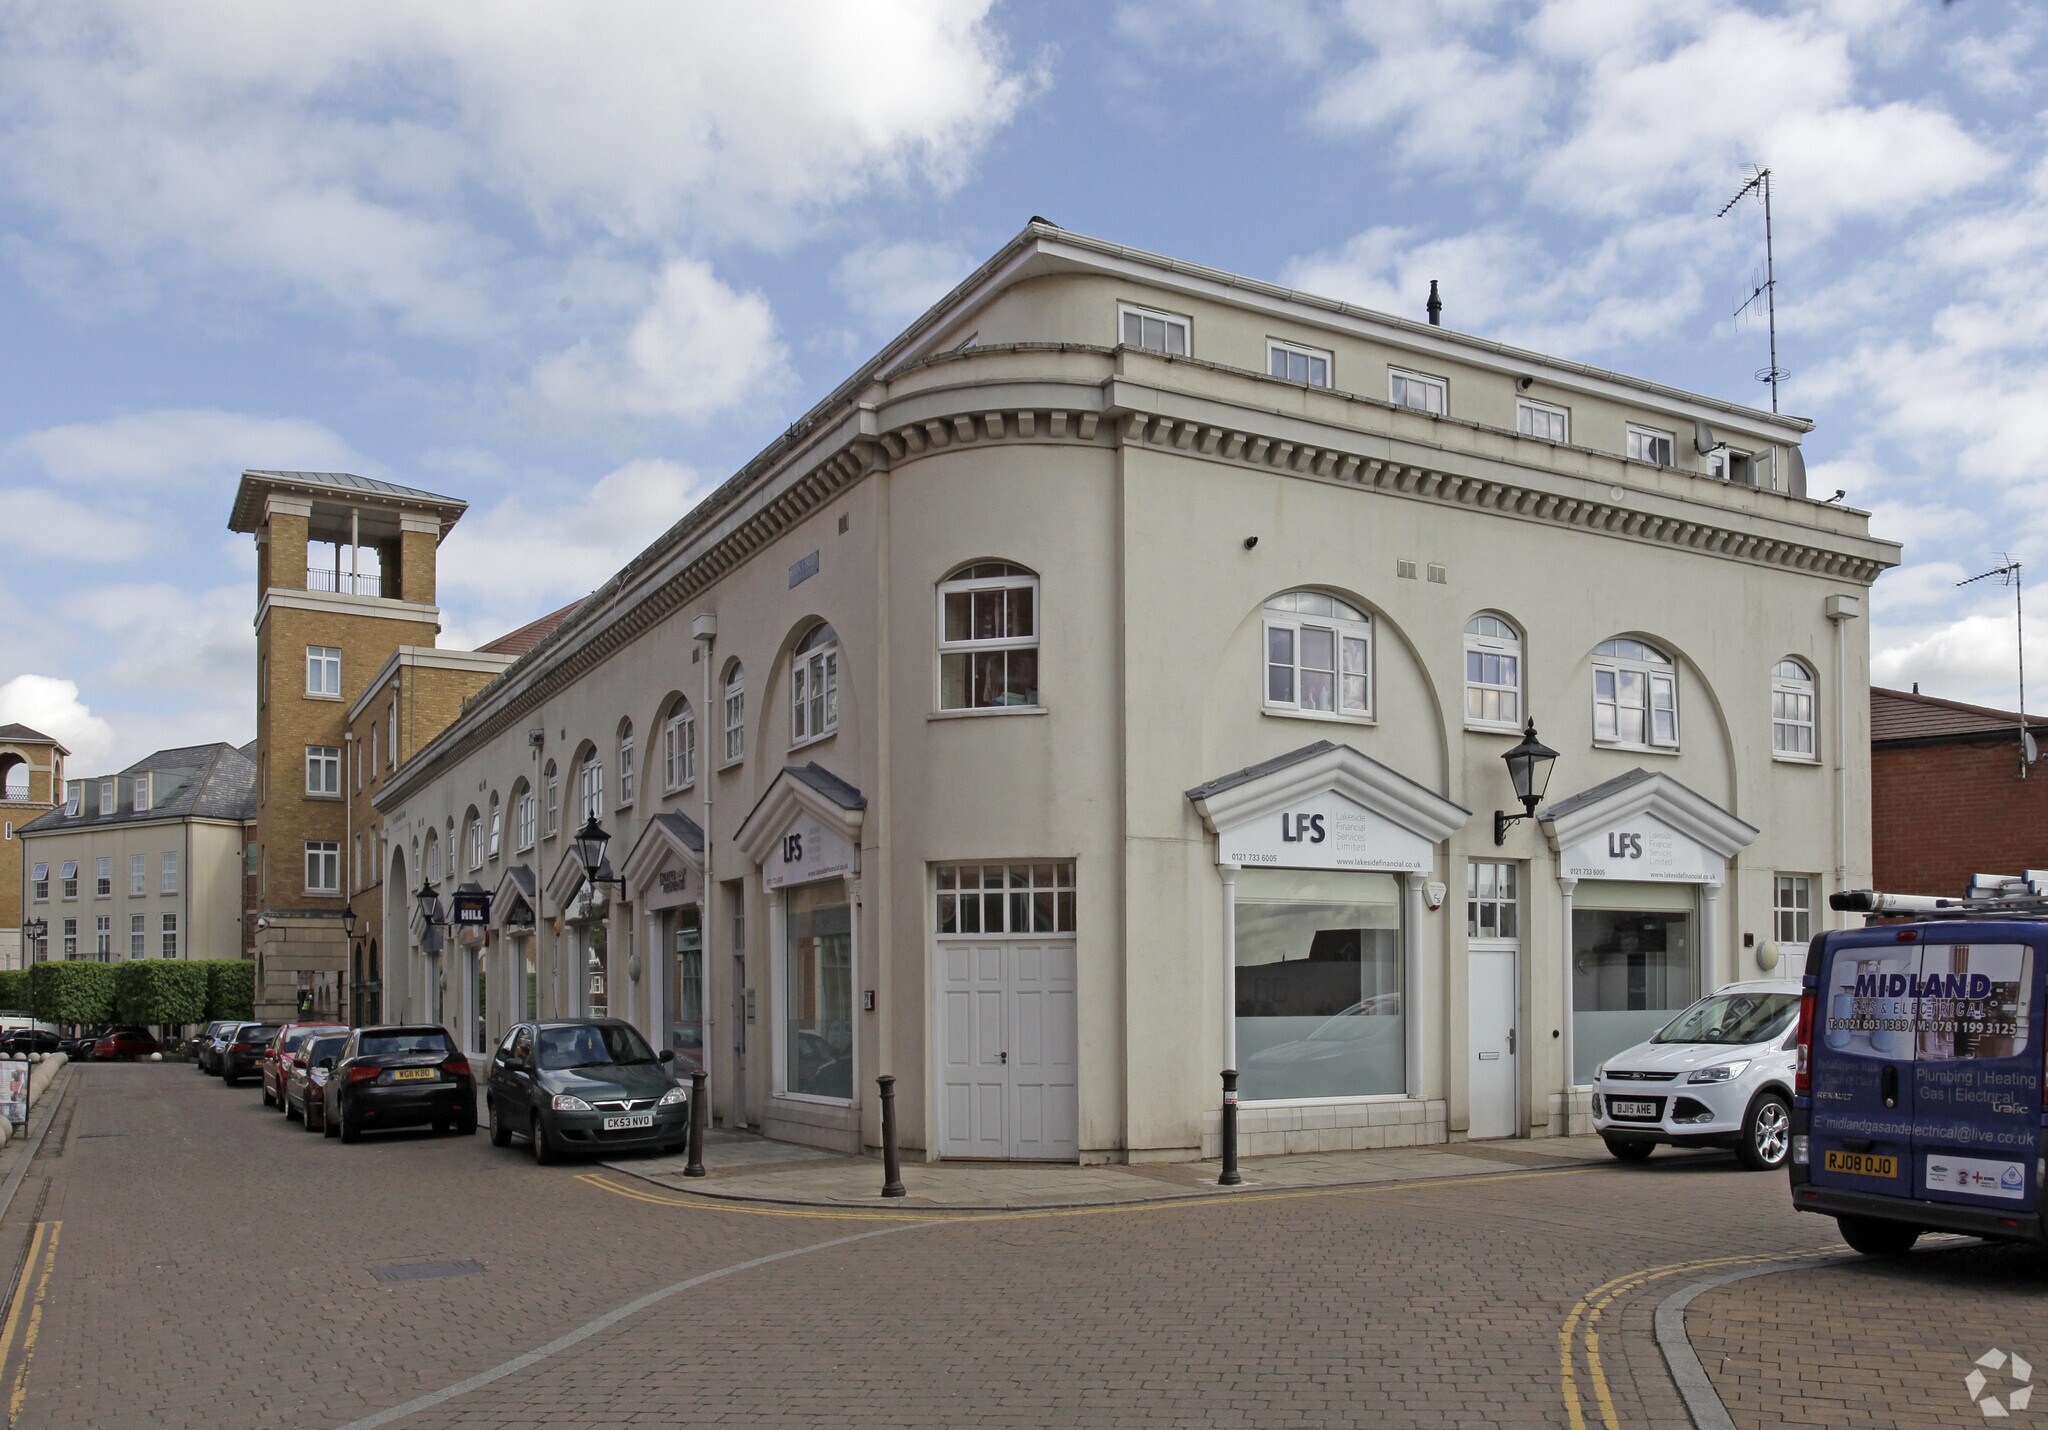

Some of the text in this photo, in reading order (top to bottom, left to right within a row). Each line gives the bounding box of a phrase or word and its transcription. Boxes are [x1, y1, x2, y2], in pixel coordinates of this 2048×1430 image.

[1336, 812, 1366, 822] Lakeside
[1282, 812, 1326, 844] LFS
[1336, 822, 1366, 831] Financial
[1336, 832, 1366, 842] Services
[783, 833, 803, 863] LFS
[1336, 842, 1366, 851] Limited
[1608, 832, 1643, 859] LFS
[1232, 853, 1277, 862] 0121 733 6005
[1336, 858, 1421, 869] www.lakesidefinancial.co.uk
[1583, 868, 1592, 876] 733
[1650, 871, 1716, 880] www.lakesidefinancial.co.uk
[461, 909, 483, 920] HILL
[1853, 973, 1992, 999] MIDLAND
[1851, 1001, 1876, 1015] GAS
[1893, 1002, 1986, 1017] ELECTRICAL
[1838, 1019, 1861, 1030] 0121
[1862, 1020, 1880, 1031] 603
[1931, 1021, 1959, 1032] 0781
[1962, 1022, 1984, 1033] 199
[1986, 1023, 2017, 1035] 3125
[1916, 1068, 1973, 1087] Plumbing
[1984, 1071, 2037, 1089] Heating
[1817, 1091, 1853, 1100] RENAULT
[1920, 1086, 1944, 1100] Gas
[1955, 1088, 2014, 1103] Electrical
[1617, 1104, 1651, 1114] BJ15 AHE
[1992, 1101, 2029, 1114] trafic
[608, 1116, 649, 1128] CK53 NVO
[1826, 1118, 2034, 1146] midlandgasandelectrical@live.co.uk
[1829, 1153, 1891, 1174] RJ08 OJO
